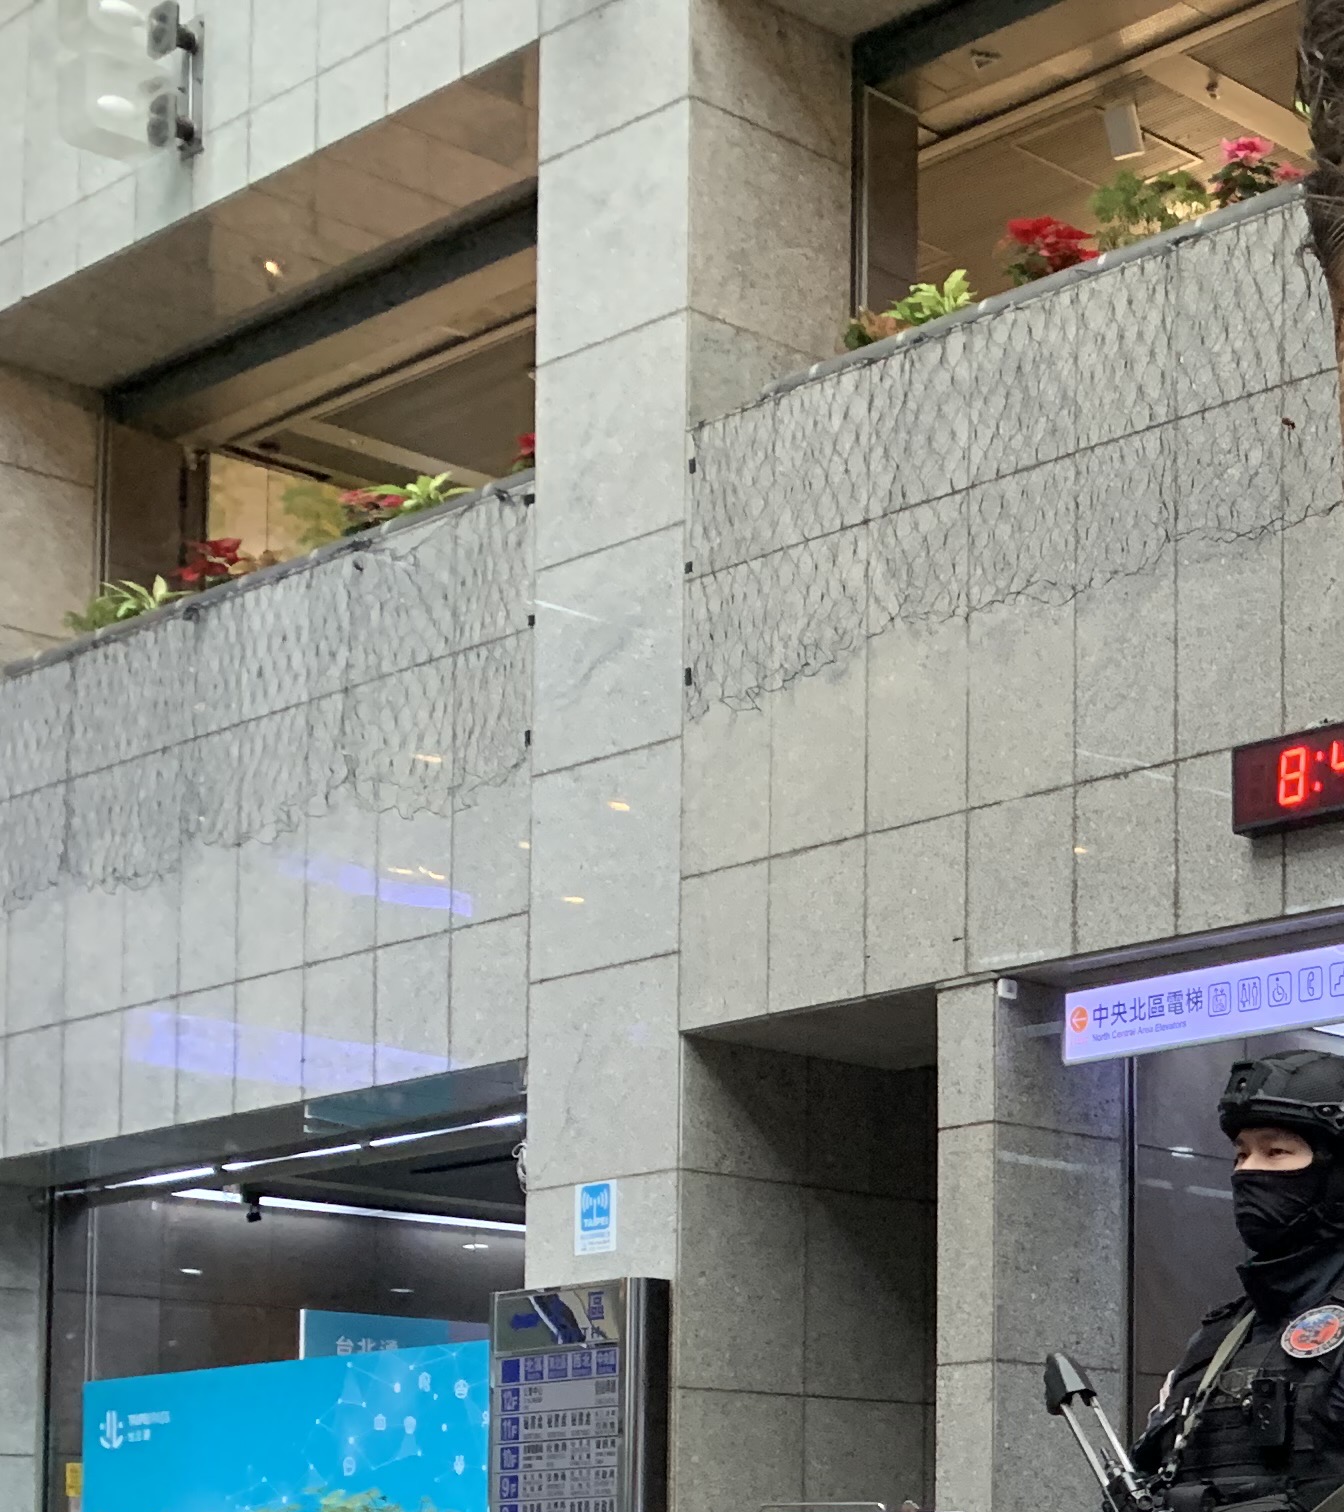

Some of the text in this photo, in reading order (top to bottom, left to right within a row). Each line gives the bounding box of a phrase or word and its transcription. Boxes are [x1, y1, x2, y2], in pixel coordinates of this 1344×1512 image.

[1092, 987, 1203, 1028] 中央北區電梯
[1092, 1032, 1111, 1042] North
[1112, 1028, 1136, 1039] Central
[1137, 1026, 1154, 1035] Area
[1155, 1021, 1187, 1033] Elevators
[501, 1477, 517, 1498] 9F
